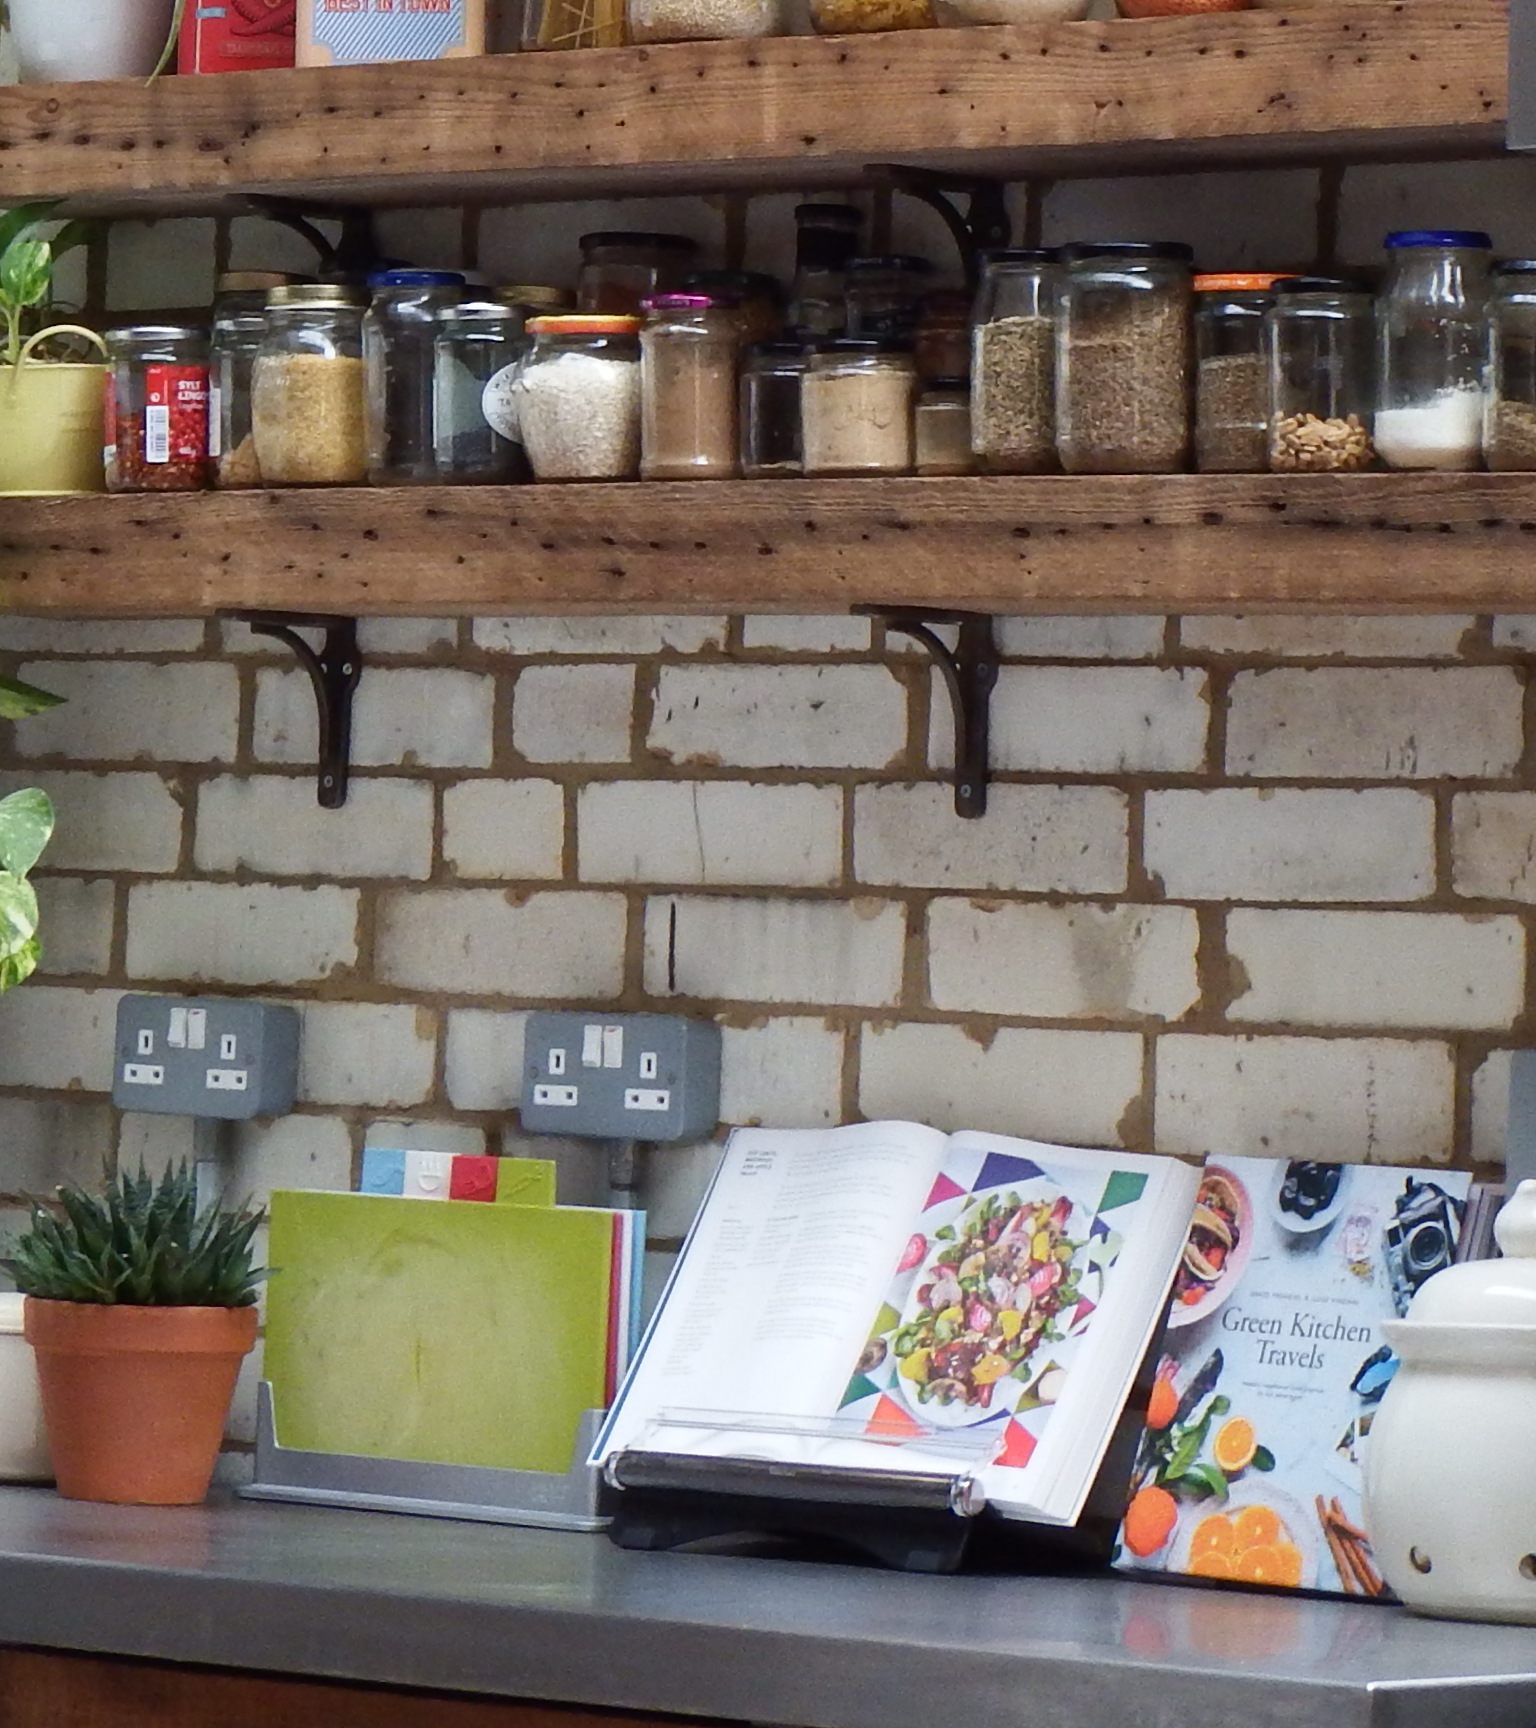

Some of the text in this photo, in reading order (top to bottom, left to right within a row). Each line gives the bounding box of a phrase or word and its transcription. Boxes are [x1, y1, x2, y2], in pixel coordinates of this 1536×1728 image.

[1222, 1306, 1371, 1343] Green Kitchen
[1256, 1339, 1325, 1369] Travels
